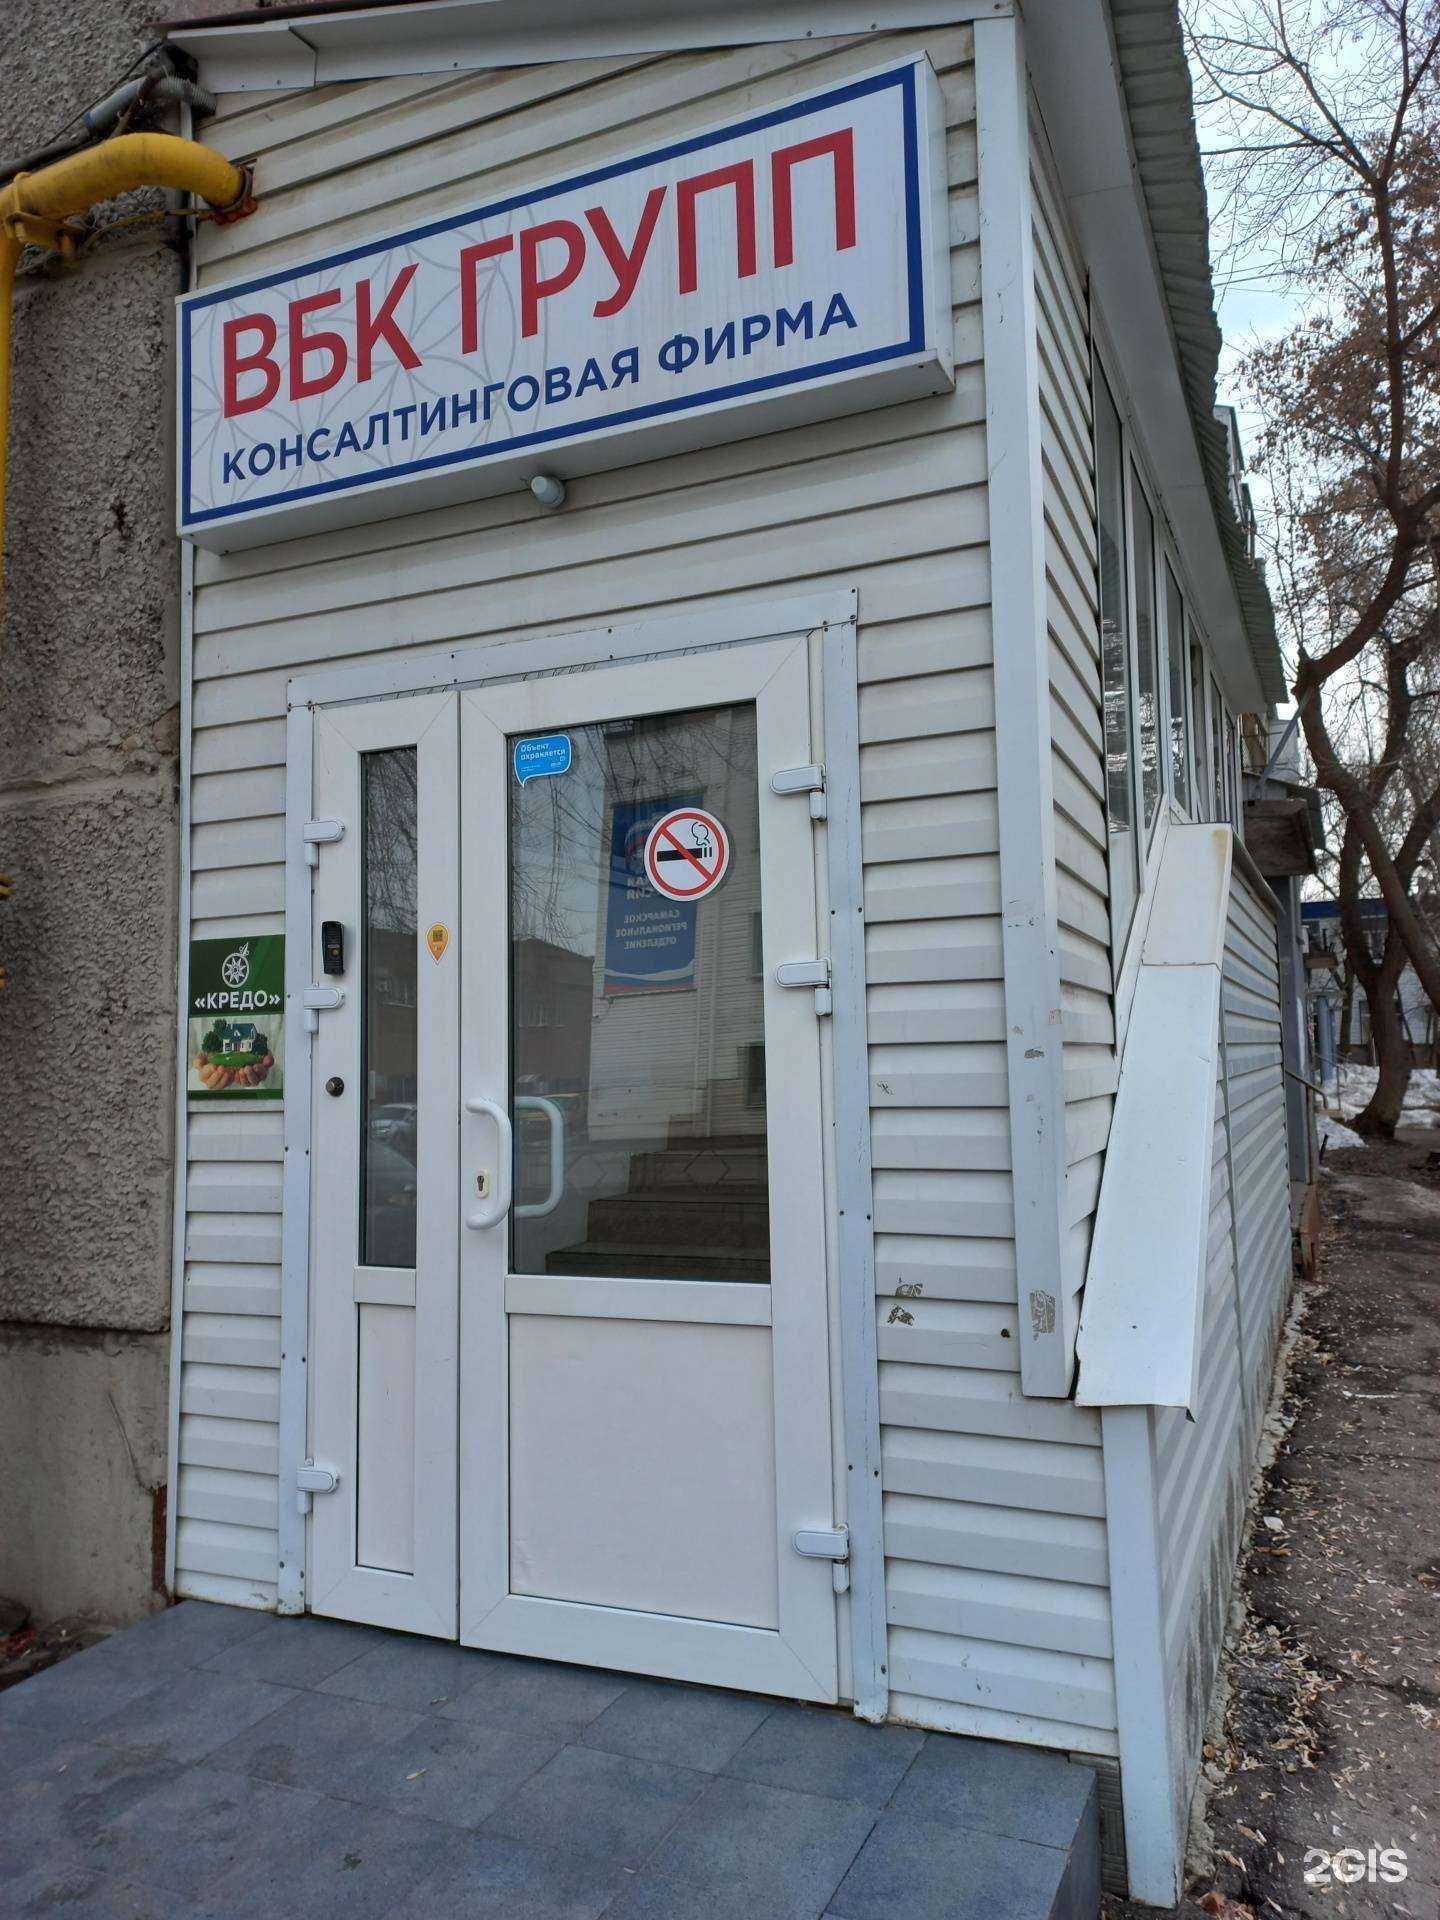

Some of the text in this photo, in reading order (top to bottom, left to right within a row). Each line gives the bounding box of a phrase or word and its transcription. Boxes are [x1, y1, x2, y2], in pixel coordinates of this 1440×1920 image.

[222, 127, 857, 419] ВБК ГРУПП
[222, 292, 858, 484] КОНСАЛТИНГОВАЯ ФИРМА
[520, 743, 550, 753] Объект
[520, 749, 566, 761] охраняется
[194, 989, 281, 1011] «КРЕДО»
